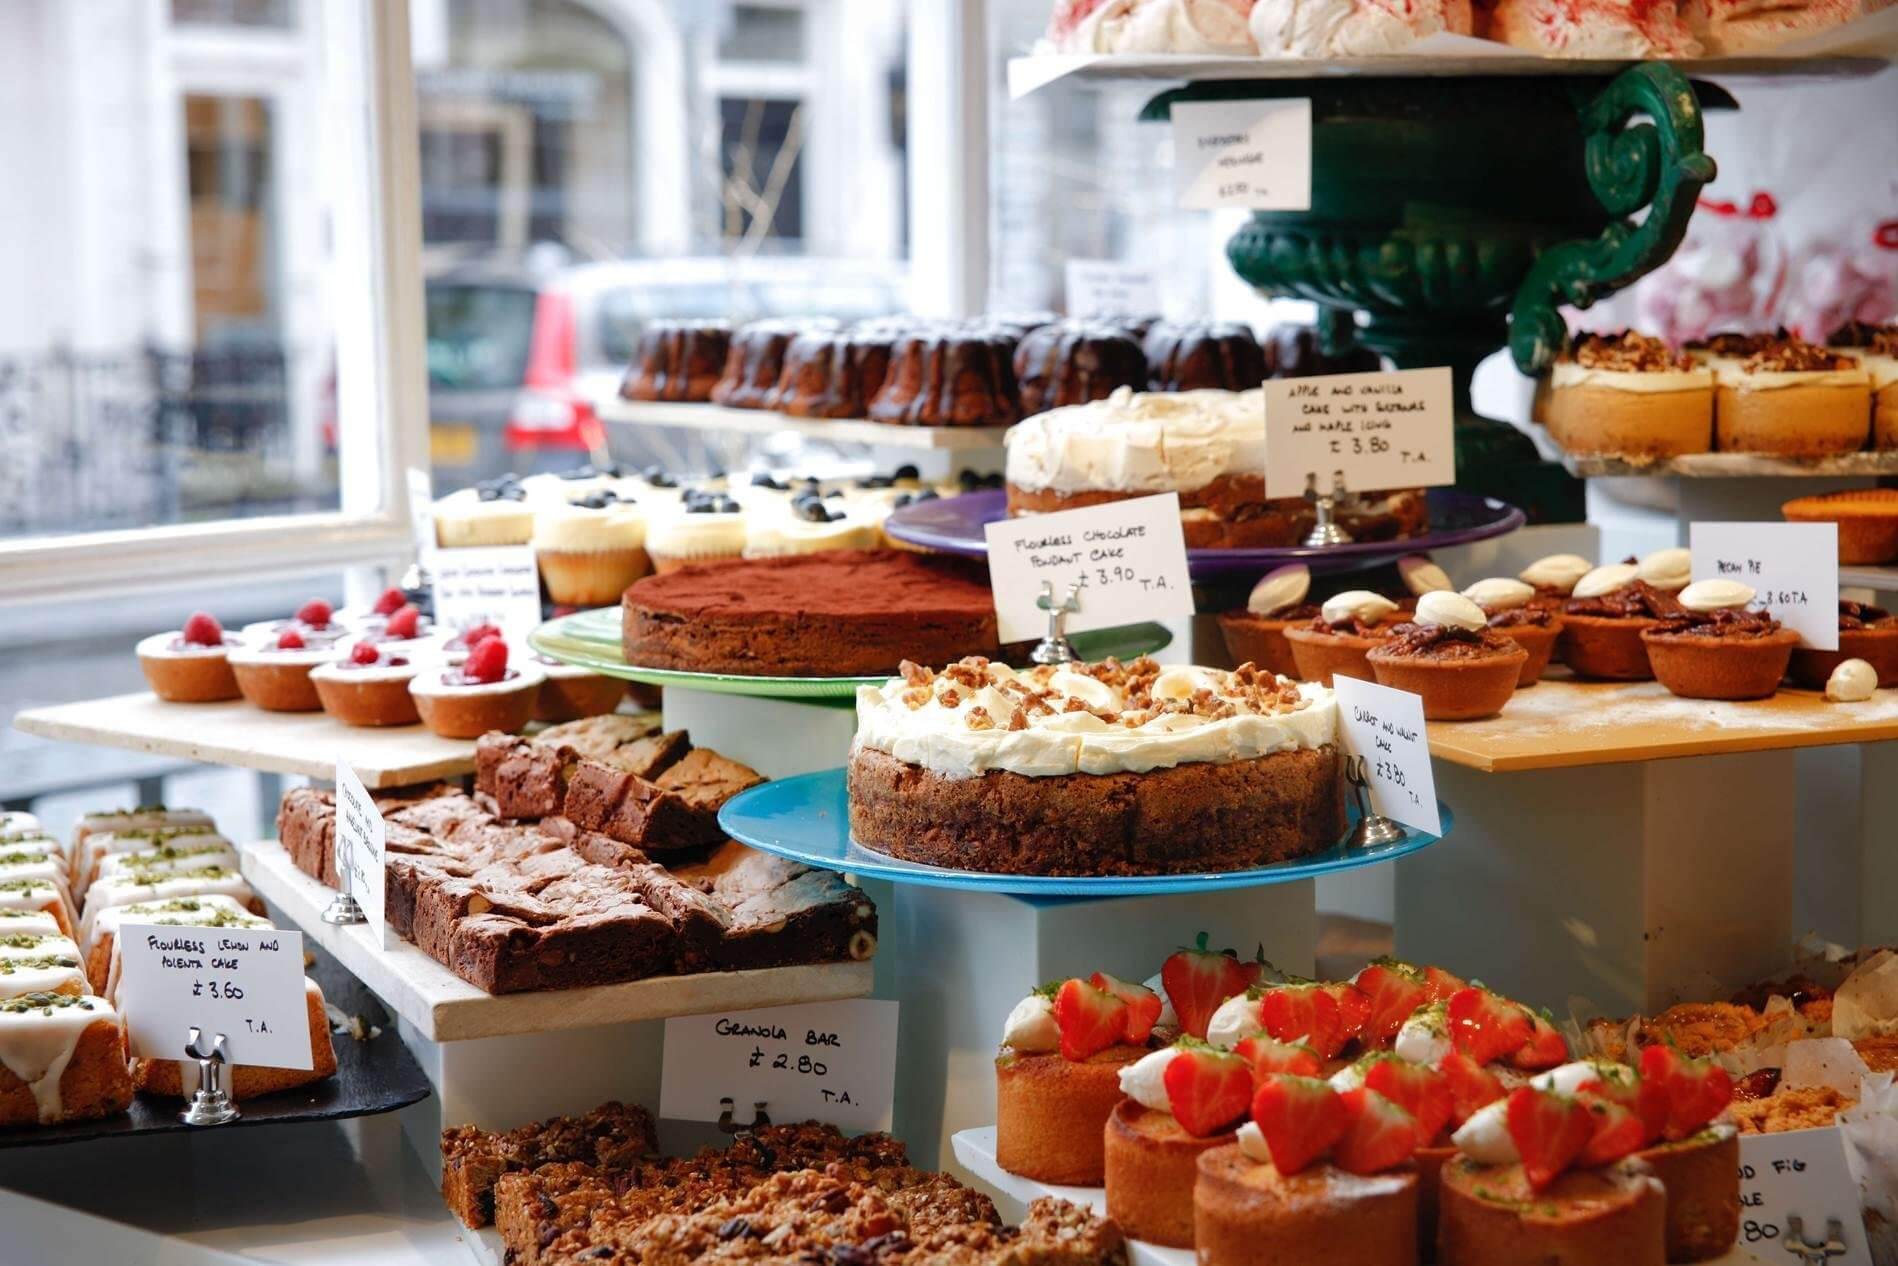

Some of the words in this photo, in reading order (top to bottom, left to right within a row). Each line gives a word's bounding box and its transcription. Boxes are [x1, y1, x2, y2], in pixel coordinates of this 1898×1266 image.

[1082, 525, 1147, 542] CHOCOLATE
[1089, 547, 1124, 562] CAKE
[217, 939, 249, 952] LEMON
[259, 939, 280, 952] AND
[211, 958, 239, 970] CAKE
[715, 1018, 787, 1041] GRANOLA
[805, 1029, 841, 1047] BAR
